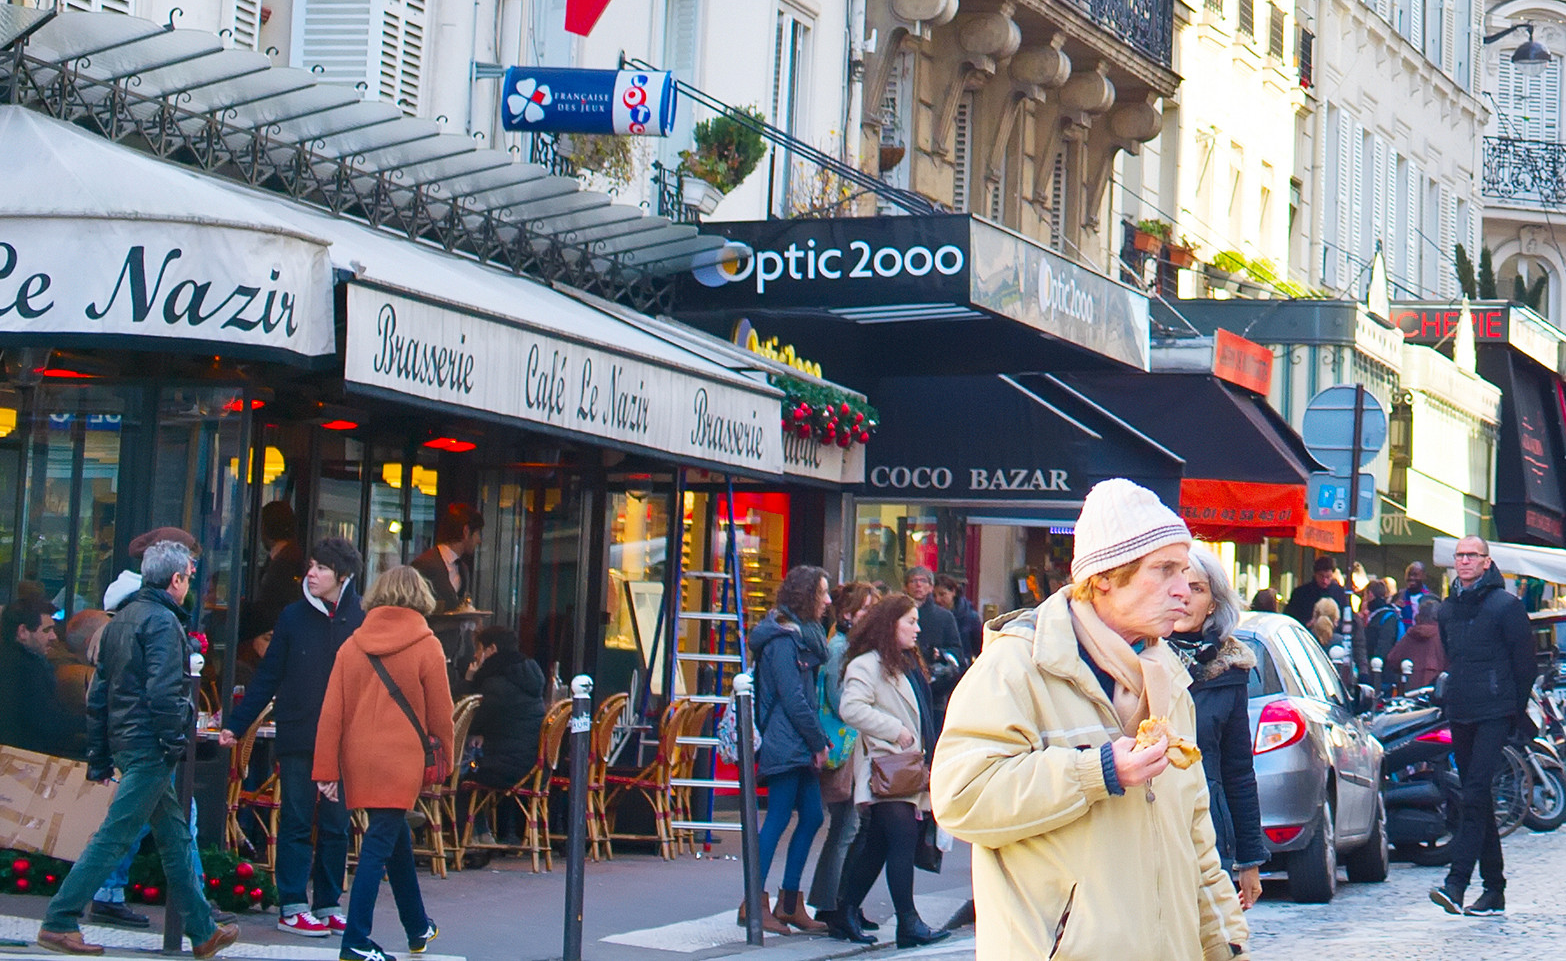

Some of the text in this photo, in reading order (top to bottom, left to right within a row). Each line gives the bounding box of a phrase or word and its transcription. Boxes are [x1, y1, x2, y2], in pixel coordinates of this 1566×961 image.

[554, 91, 609, 103] FRANÇAISE
[557, 103, 605, 113] DES JEUX
[622, 75, 652, 135] LOTO
[717, 238, 964, 294] Optic 2000
[85, 245, 299, 338] Nazir
[1069, 279, 1094, 324] 2000
[1390, 311, 1502, 338] CHEIE
[374, 302, 475, 394] Brasserie
[525, 343, 566, 416] Café
[576, 357, 598, 420] Le
[602, 365, 651, 435] Nazir
[690, 387, 765, 461] Brasserie
[870, 465, 1072, 493] COCO BAZAR
[1220, 510, 1235, 521] 42
[1278, 510, 1292, 521] 01
